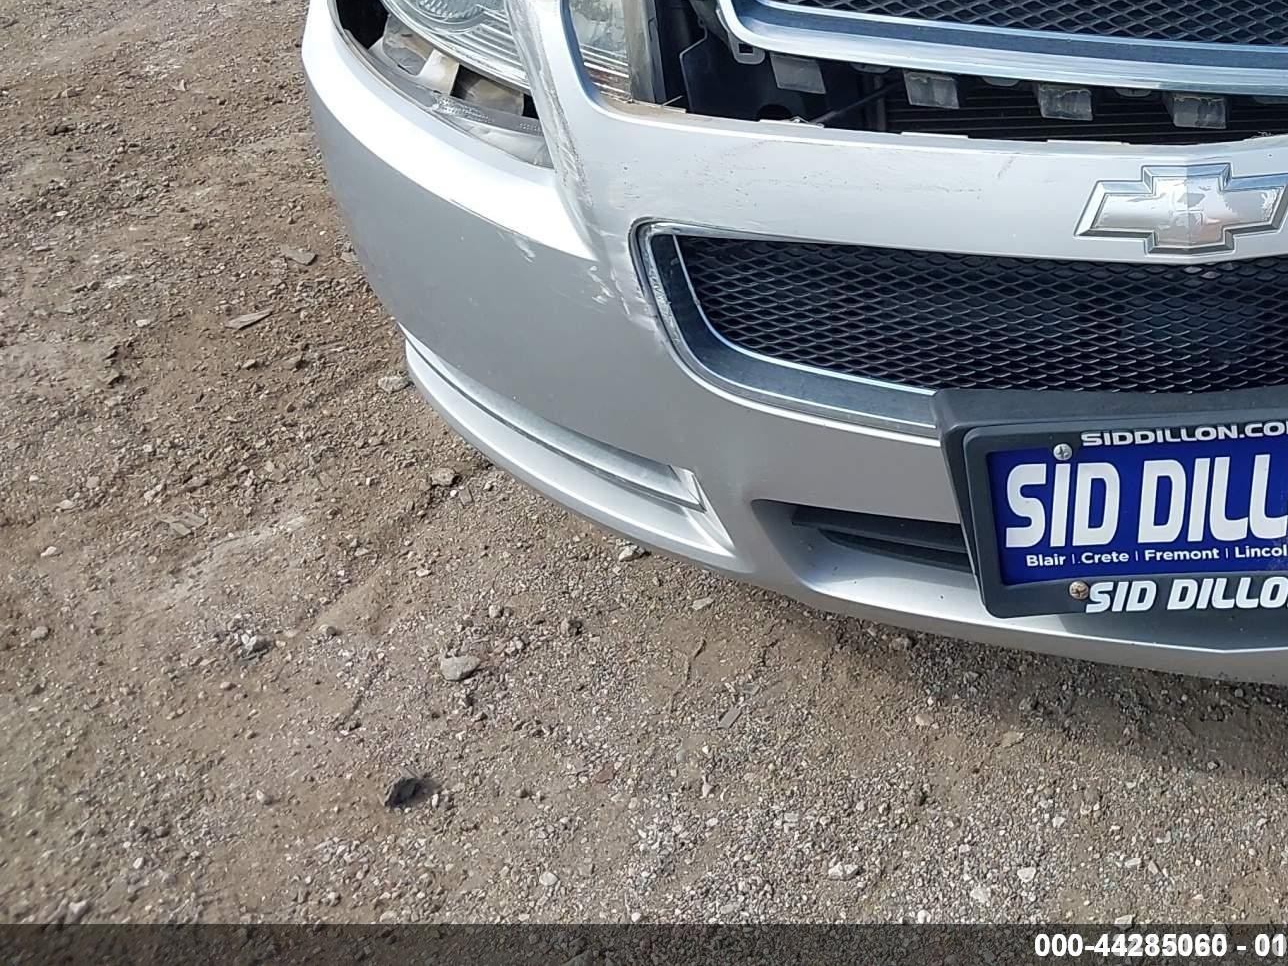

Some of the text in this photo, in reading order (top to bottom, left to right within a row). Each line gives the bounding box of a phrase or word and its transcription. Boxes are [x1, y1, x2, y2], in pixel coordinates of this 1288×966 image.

[1005, 462, 1120, 548] SID
[1026, 552, 1066, 567] Blair
[1081, 551, 1130, 564] Crete
[1144, 547, 1220, 561] Fremont
[1085, 580, 1157, 613] SID
